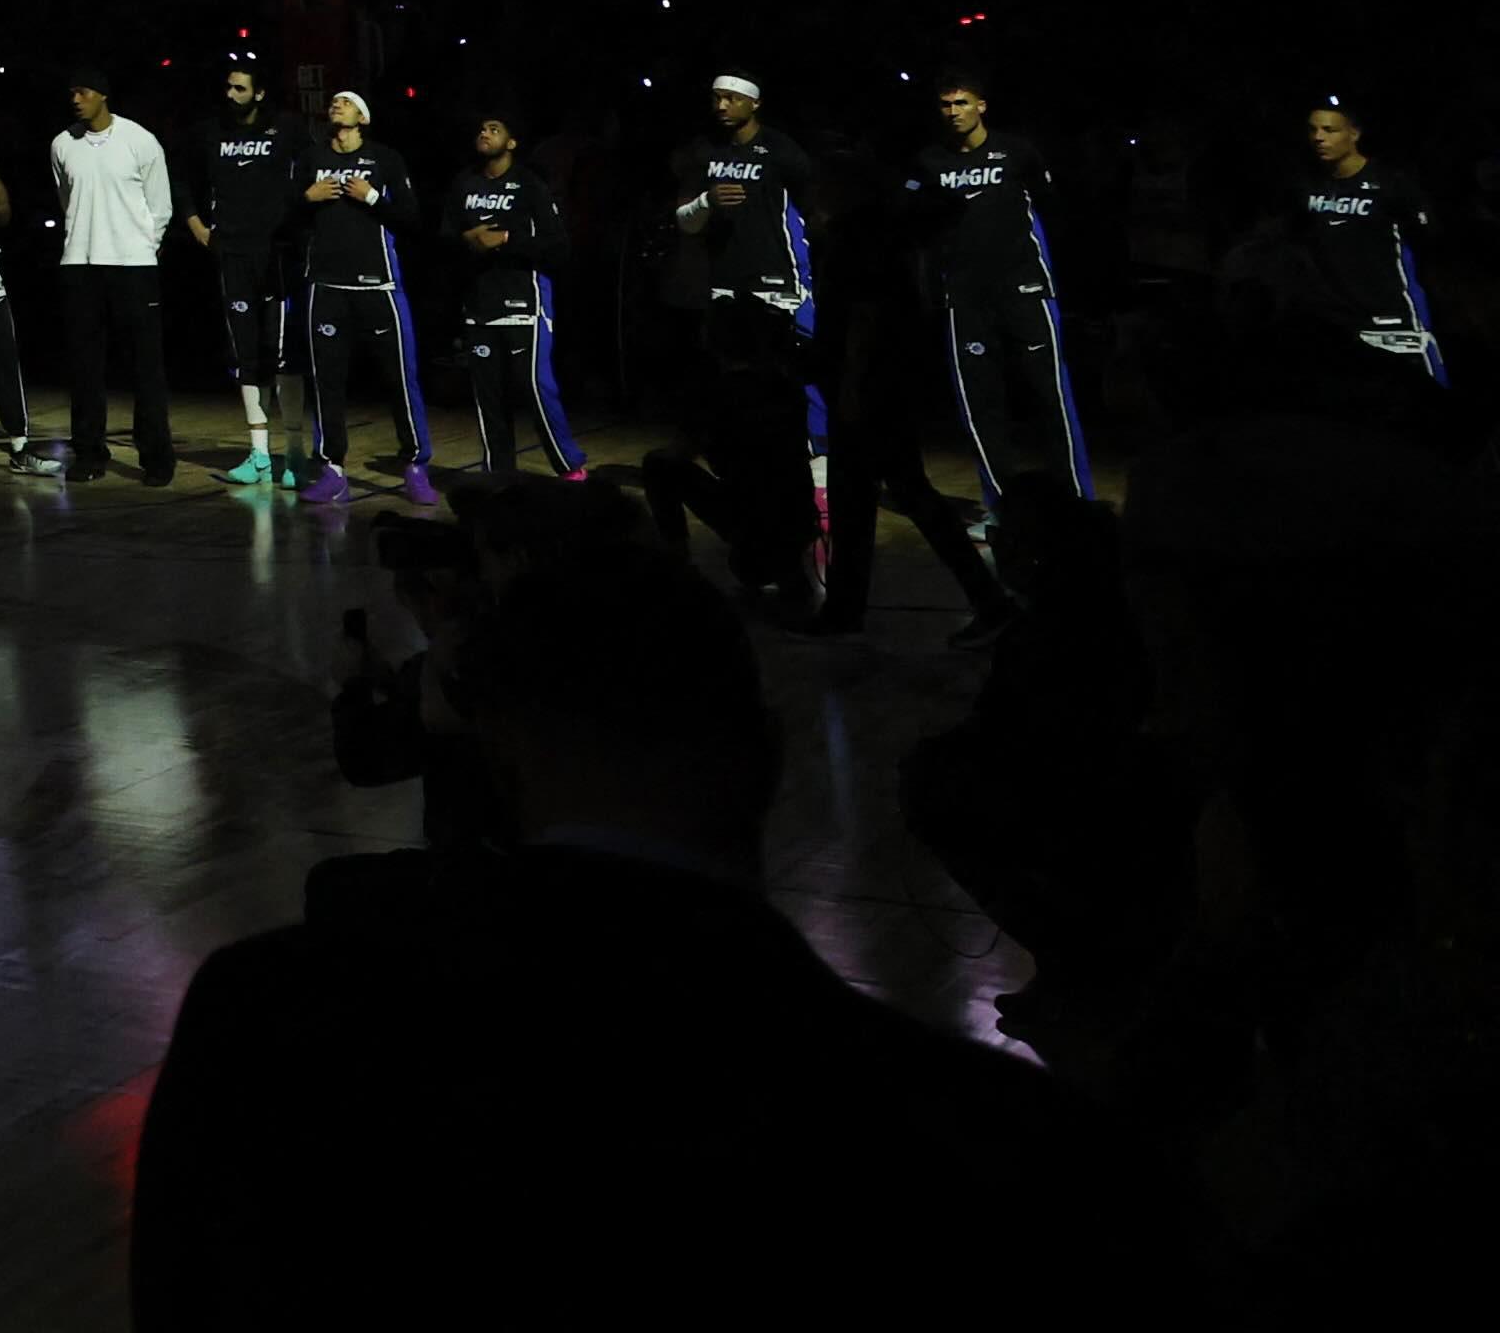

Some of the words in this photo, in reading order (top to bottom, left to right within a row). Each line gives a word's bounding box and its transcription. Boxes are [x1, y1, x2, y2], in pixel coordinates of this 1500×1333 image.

[219, 140, 273, 158] MAGIC
[707, 161, 763, 180] MAGIC
[940, 167, 1003, 189] MAGIC
[465, 194, 515, 211] MAGIC
[1308, 195, 1372, 216] MAGIC
